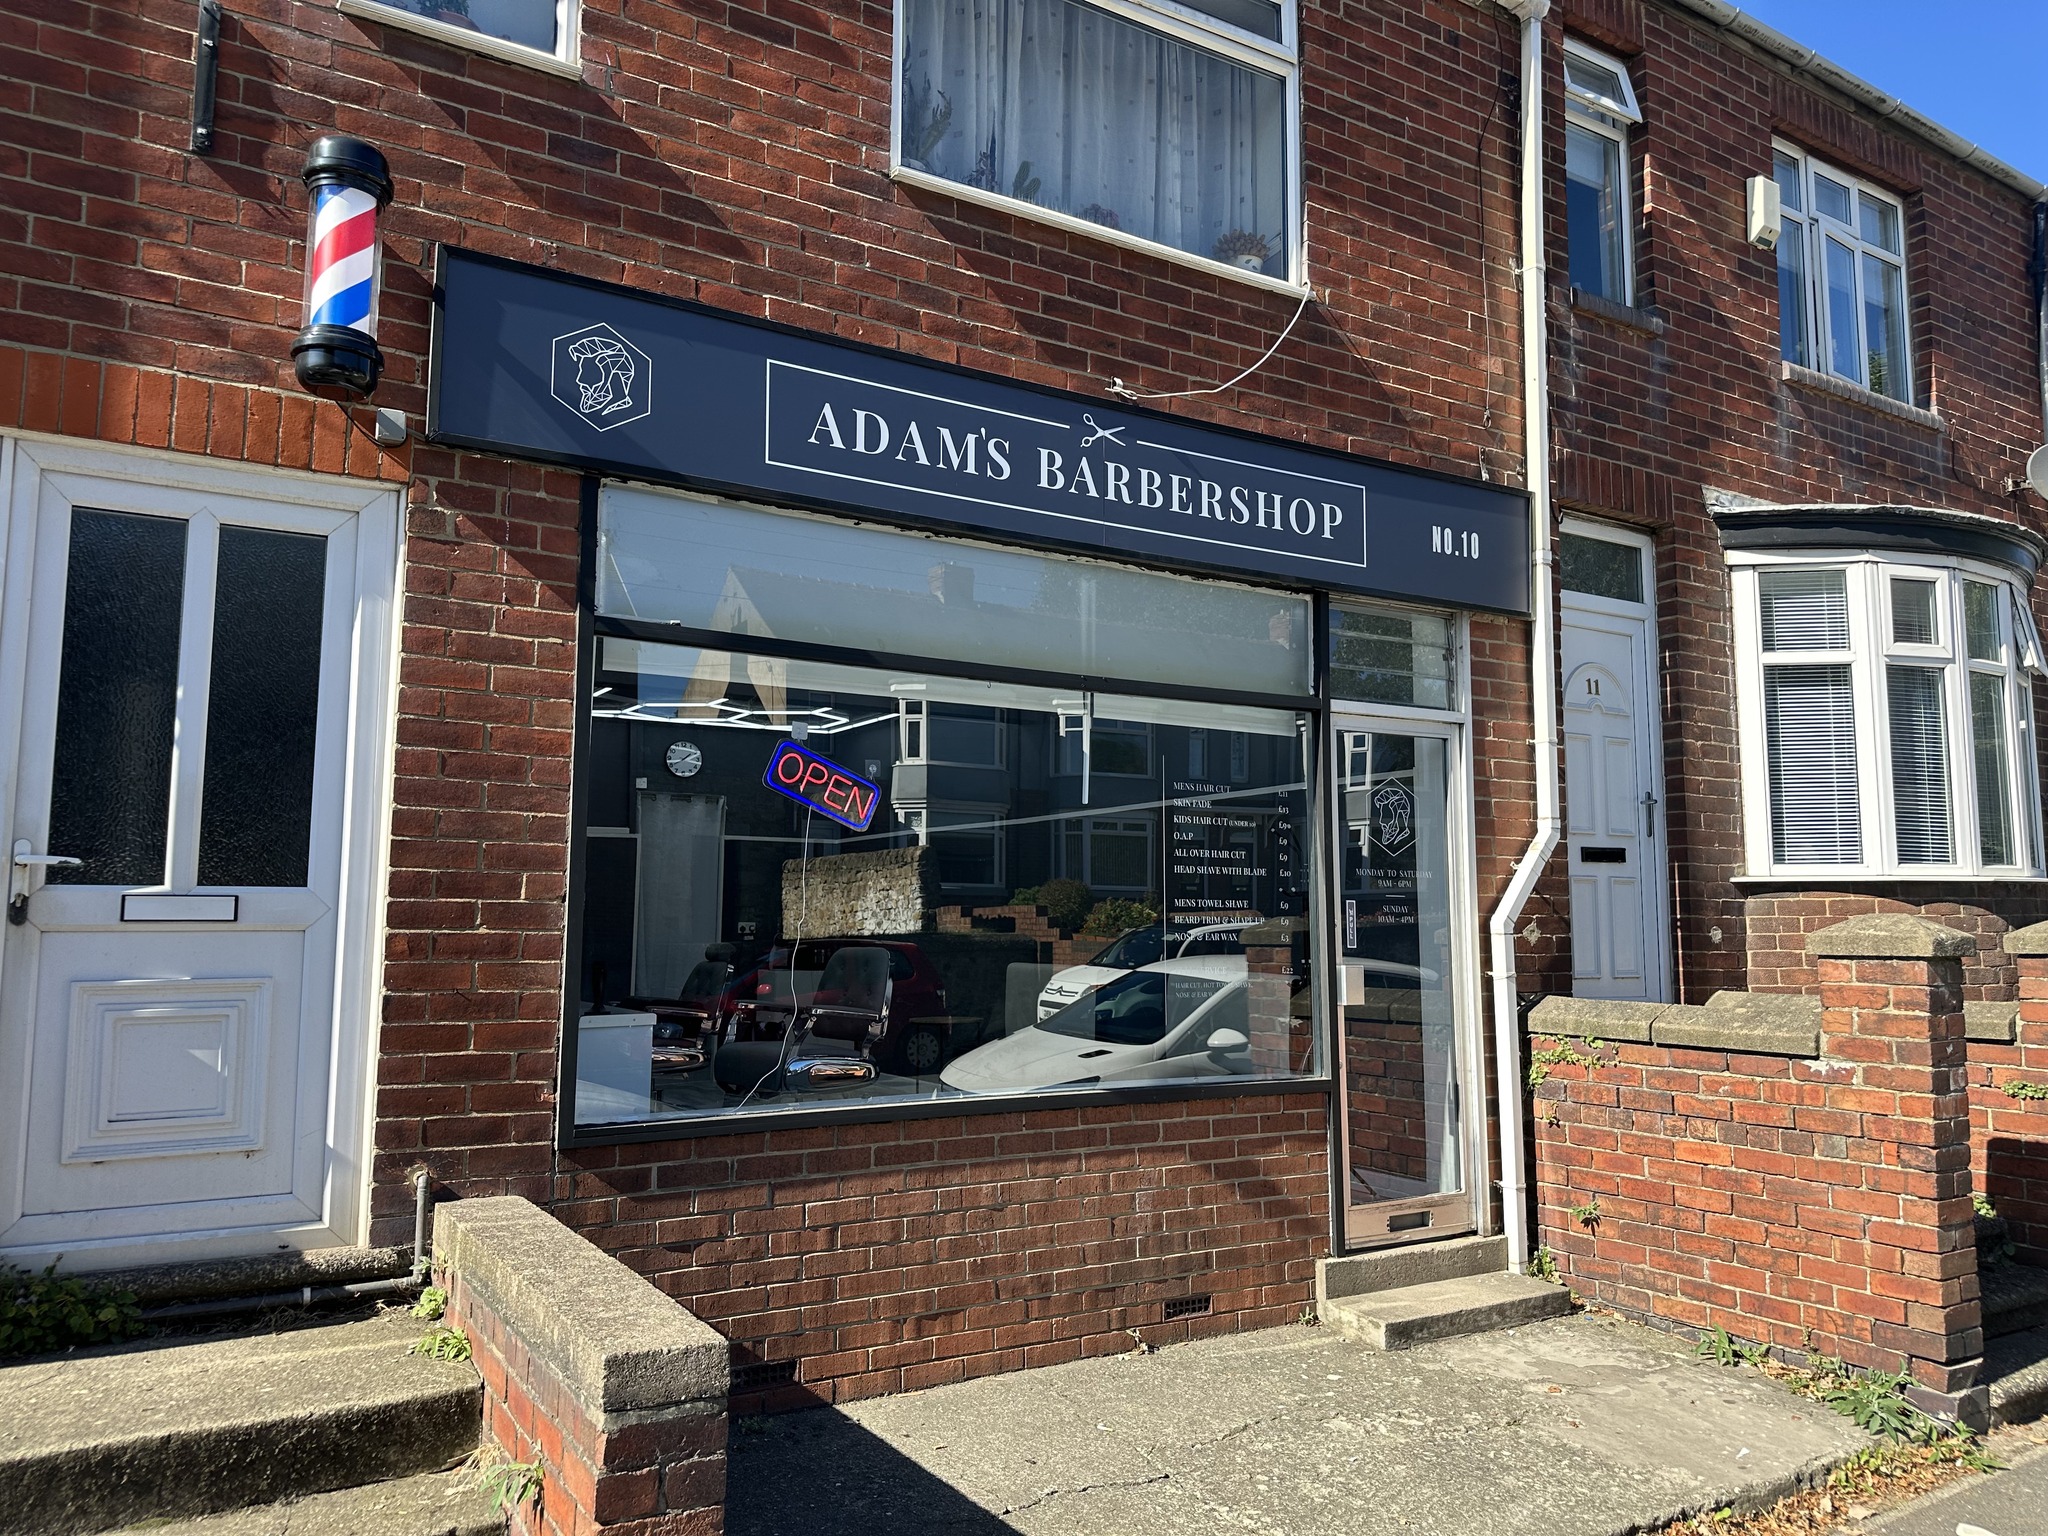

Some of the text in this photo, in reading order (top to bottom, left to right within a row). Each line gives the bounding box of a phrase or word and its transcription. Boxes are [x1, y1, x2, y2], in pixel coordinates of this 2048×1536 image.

[807, 402, 1343, 540] ADAM'S BARBERSHOP
[1432, 525, 1480, 560] NO.10
[1585, 678, 1601, 696] 11
[778, 752, 874, 819] OPEN
[1174, 782, 1231, 794] MENS HAIR CUT
[1174, 799, 1212, 808] SKIN FADE
[1278, 805, 1289, 814] £13
[1174, 815, 1192, 823] KIDS
[1193, 816, 1212, 825] HAIR
[1212, 817, 1228, 826] CUT
[1174, 832, 1193, 840] O.A.P
[1279, 837, 1288, 846] £9
[1174, 849, 1246, 860] ALL OVER HAIR CUT
[1279, 853, 1288, 862] £9
[1174, 865, 1267, 876] HEAD SHAVE WITH BLADE
[1280, 869, 1291, 877] £10
[1356, 868, 1385, 877] MONDAY
[1399, 870, 1432, 878] SATURDAY
[1398, 880, 1412, 888] 6PM
[1174, 898, 1249, 908] MENS TOWEL SHAVE
[1280, 901, 1289, 910] £9
[1382, 905, 1409, 913] SUNDAY
[1174, 916, 1200, 924] BEARD
[1201, 916, 1220, 924] TRIM
[1280, 917, 1289, 927] £9
[1378, 915, 1395, 923] 10AM
[1400, 916, 1414, 924] 4PM
[1175, 932, 1195, 941] NOSE
[1205, 933, 1220, 941] EAR
[1220, 933, 1238, 941] WAX
[1281, 934, 1289, 942] £3
[1281, 966, 1294, 974] £22
